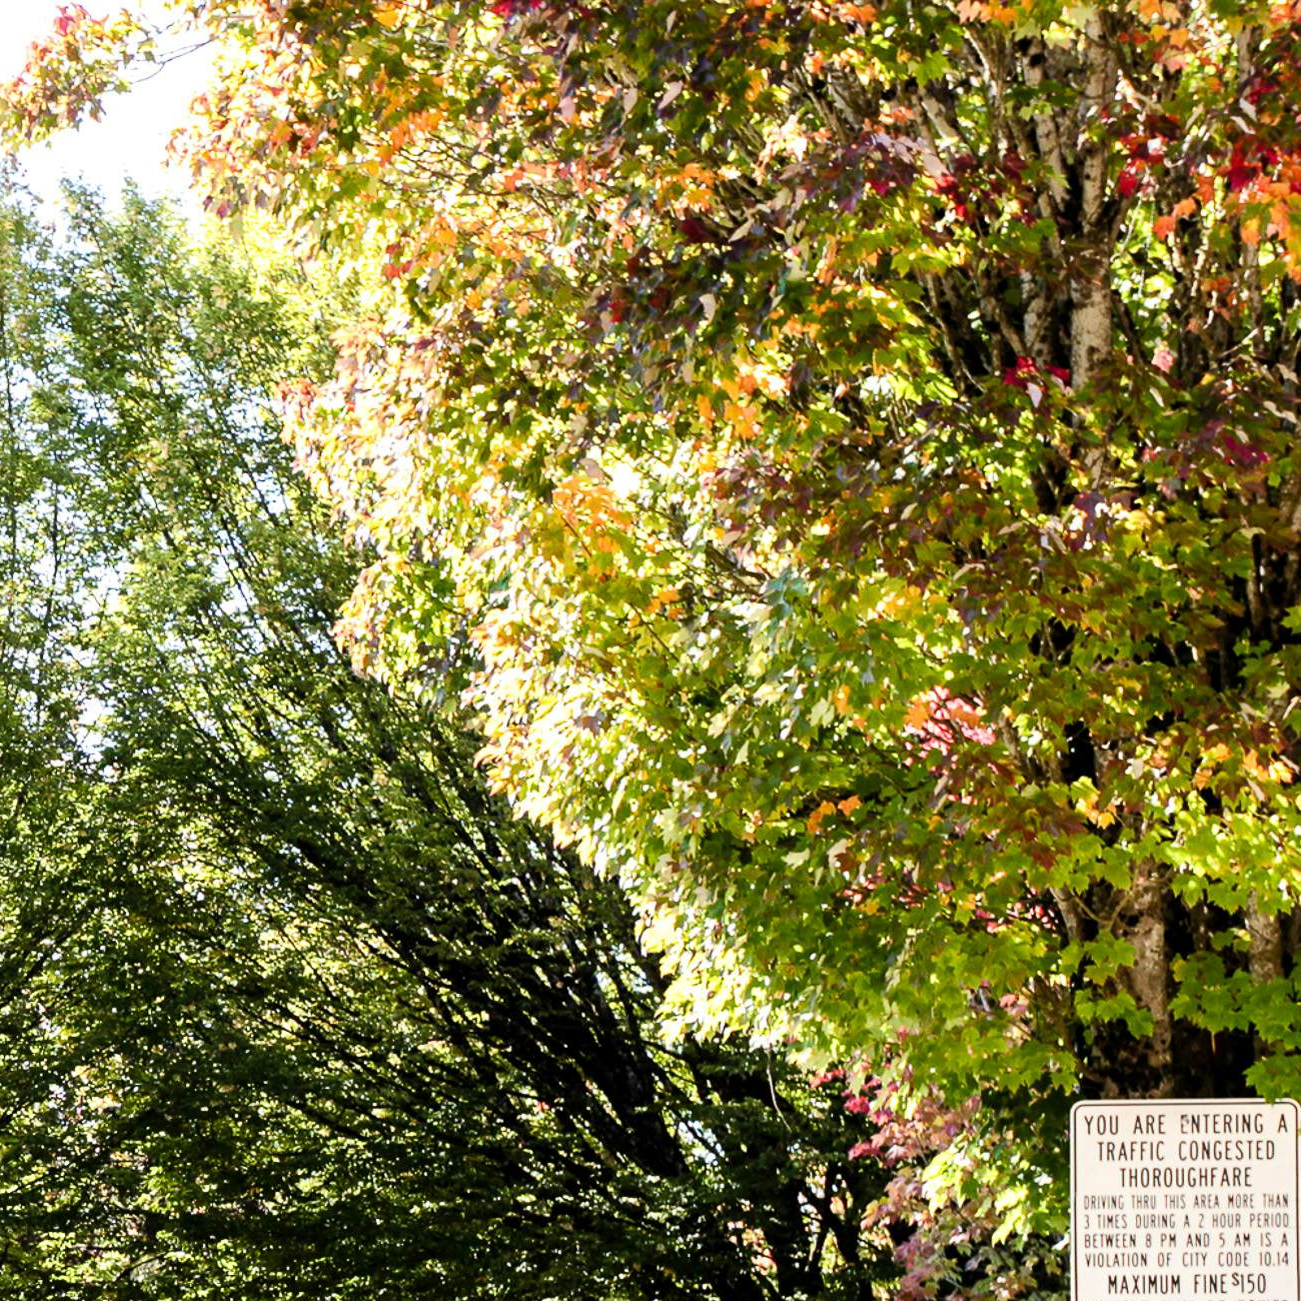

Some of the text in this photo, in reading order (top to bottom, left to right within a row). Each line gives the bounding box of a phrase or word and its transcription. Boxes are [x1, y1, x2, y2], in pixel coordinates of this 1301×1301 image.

[1084, 1113, 1288, 1135] YOU ARE ENTERING A
[1097, 1140, 1275, 1161] TRAFFIC CONGESTED
[1120, 1167, 1253, 1188] THOROUGHFARE
[1084, 1193, 1289, 1210] DRIVING THRU THIS AREA MORE THAN
[1084, 1213, 1289, 1229] 3 TIMES DURING A 2 HOUR PERIOD
[1084, 1233, 1289, 1249] BETWEEN 8 PM AND 5 AM IS A
[1085, 1251, 1289, 1268] VIOLATION OF CITY CODE 10.14
[1108, 1274, 1181, 1295] MAXIMUM
[1193, 1274, 1227, 1294] FINE
